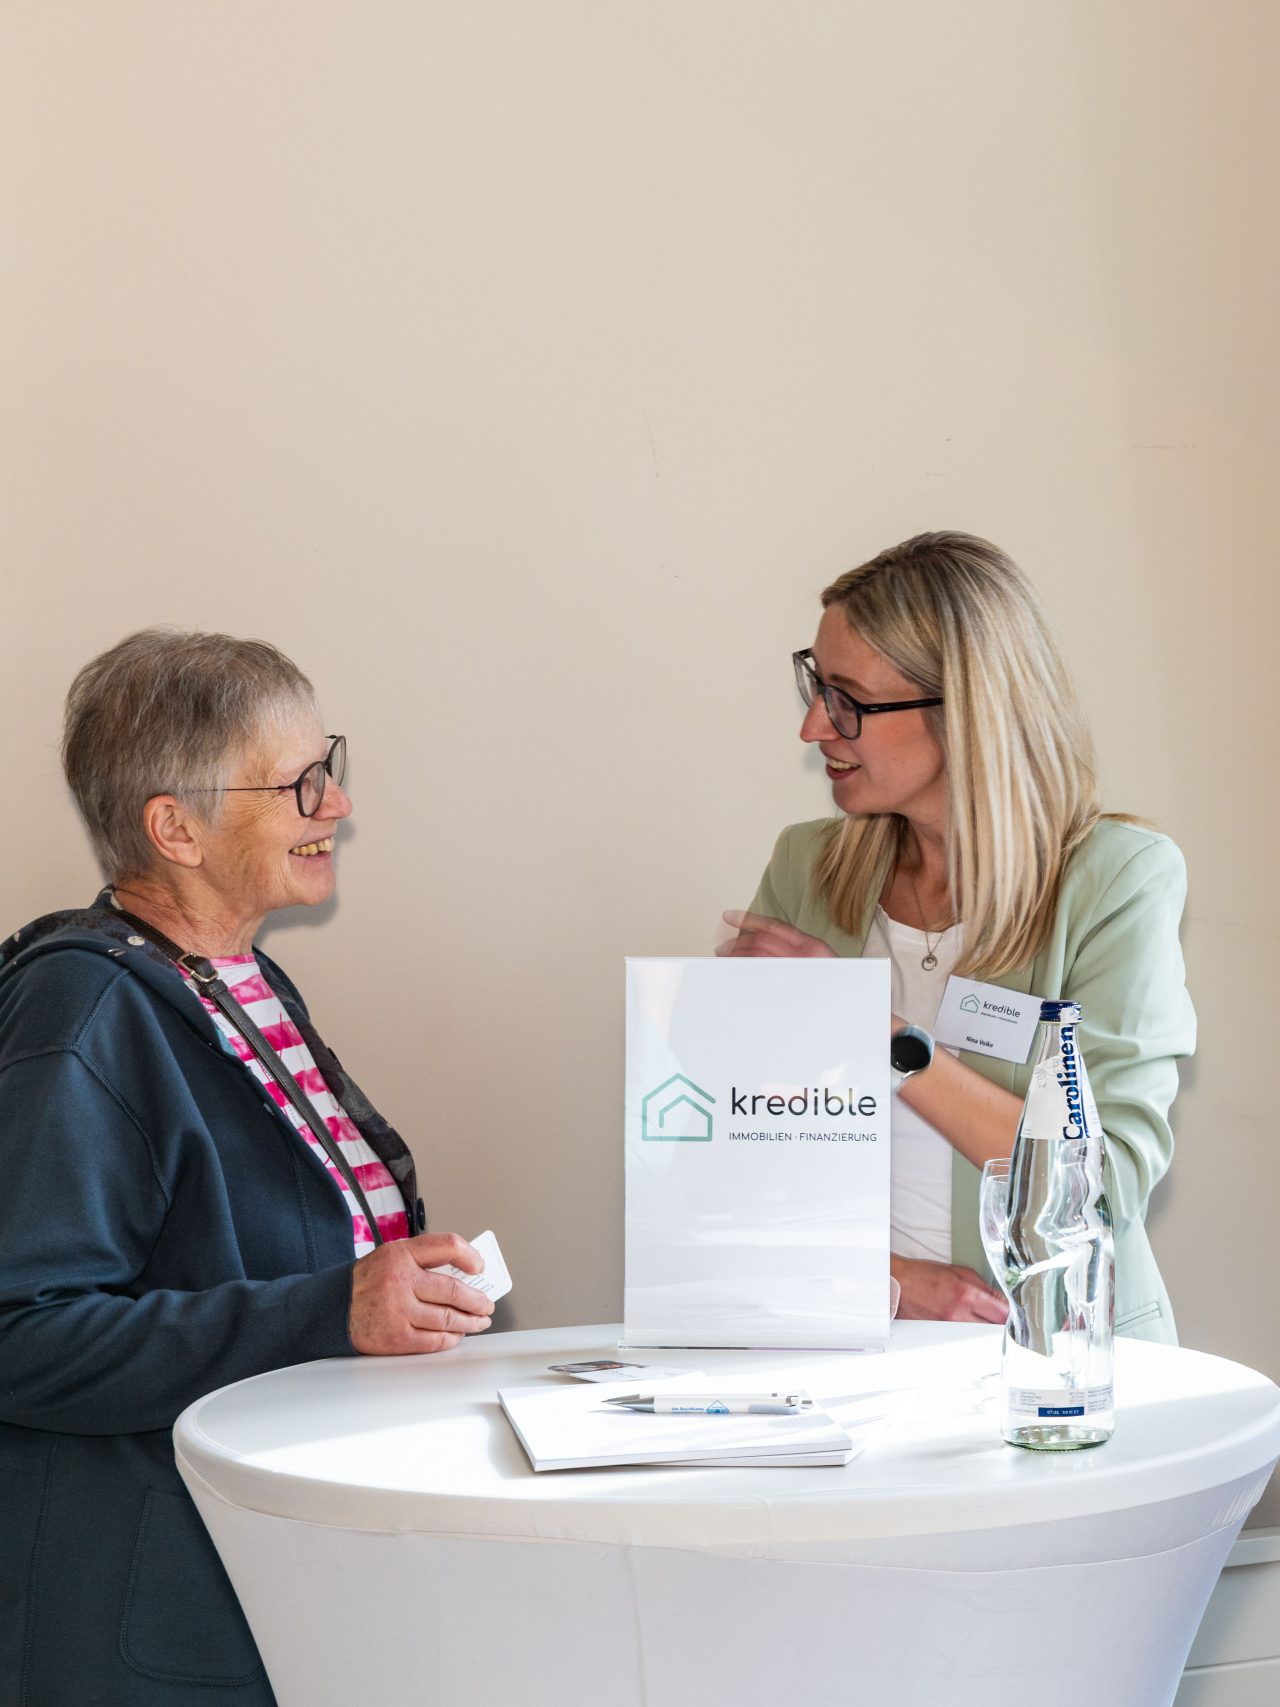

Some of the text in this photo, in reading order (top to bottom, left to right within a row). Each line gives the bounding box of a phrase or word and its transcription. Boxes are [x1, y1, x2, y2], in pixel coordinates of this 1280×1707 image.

[983, 1001, 1021, 1018] kredible
[1057, 1024, 1084, 1140] Carolinen
[731, 1086, 877, 1117] kredible
[728, 1131, 878, 1142] IMMOBILIEN FINANZIERUNG
